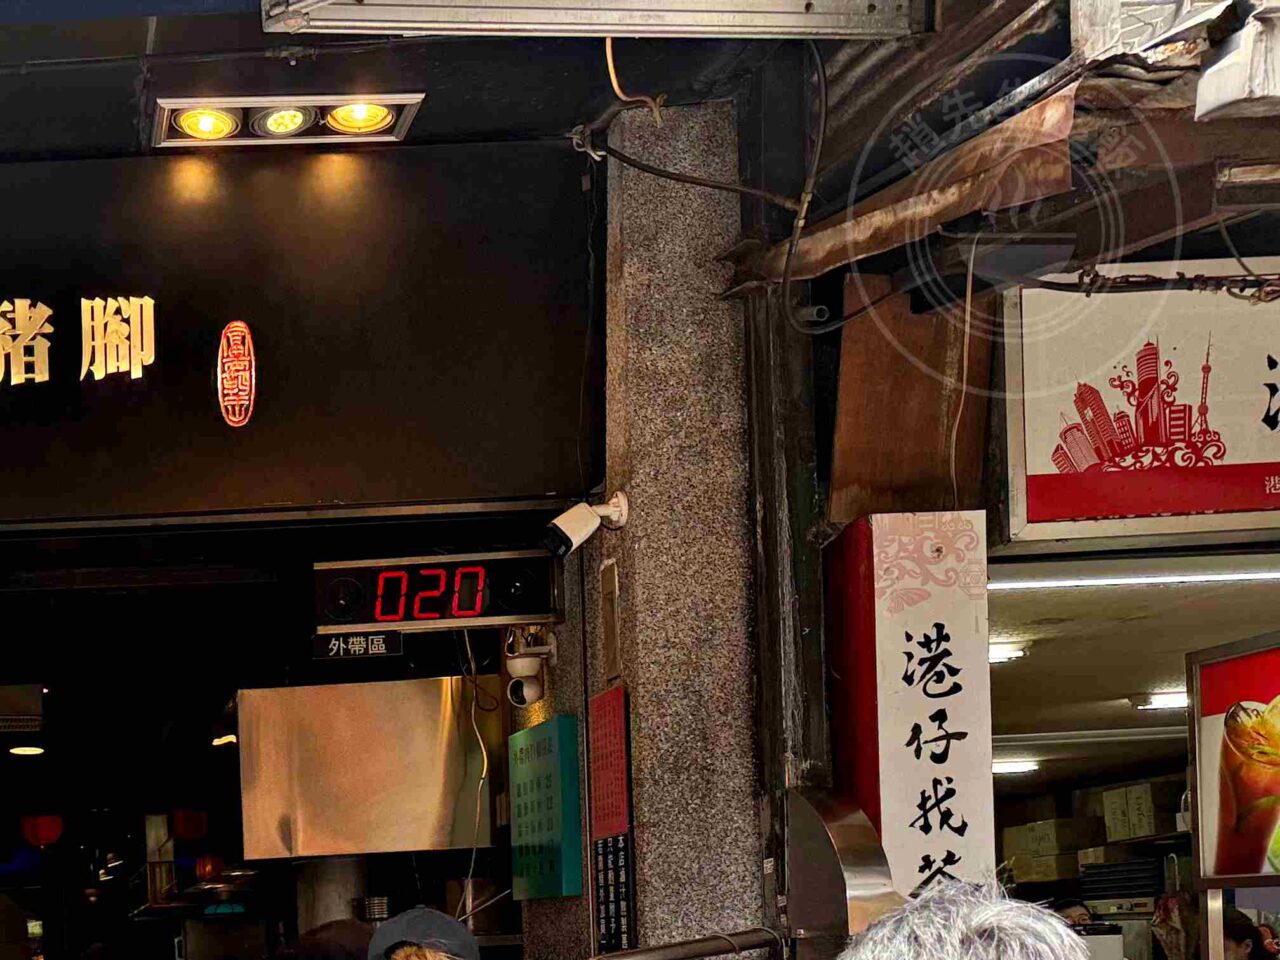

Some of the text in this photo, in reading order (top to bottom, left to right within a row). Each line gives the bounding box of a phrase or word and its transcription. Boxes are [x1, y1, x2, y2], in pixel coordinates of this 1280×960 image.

[374, 565, 486, 622] 020
[328, 635, 388, 657] 外帶區
